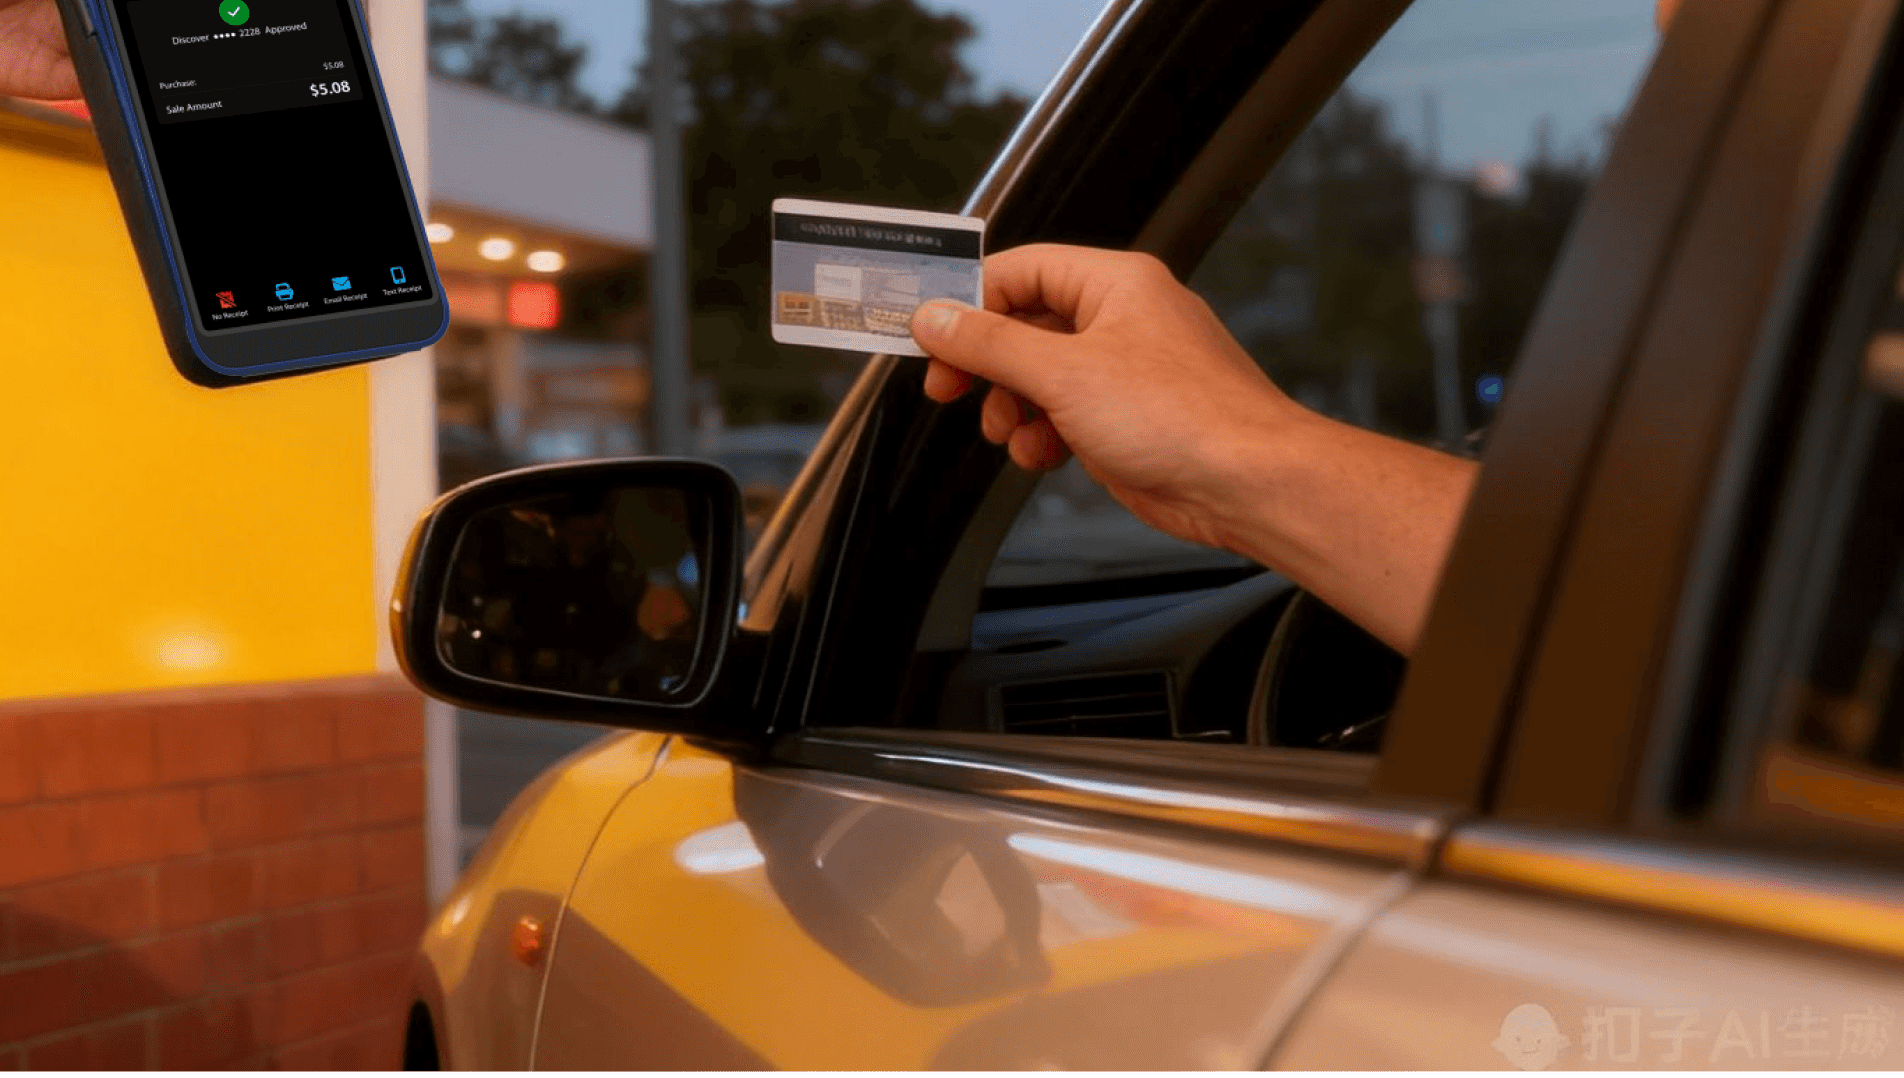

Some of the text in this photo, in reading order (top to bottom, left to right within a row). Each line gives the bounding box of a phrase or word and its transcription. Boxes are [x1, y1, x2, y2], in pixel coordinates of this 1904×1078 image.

[171, 34, 210, 46] Discover
[264, 21, 308, 36] Approved
[322, 60, 345, 71] $5.08
[309, 80, 351, 98] $5.08
[165, 100, 223, 115] Sale Amount
[323, 296, 343, 305] Email
